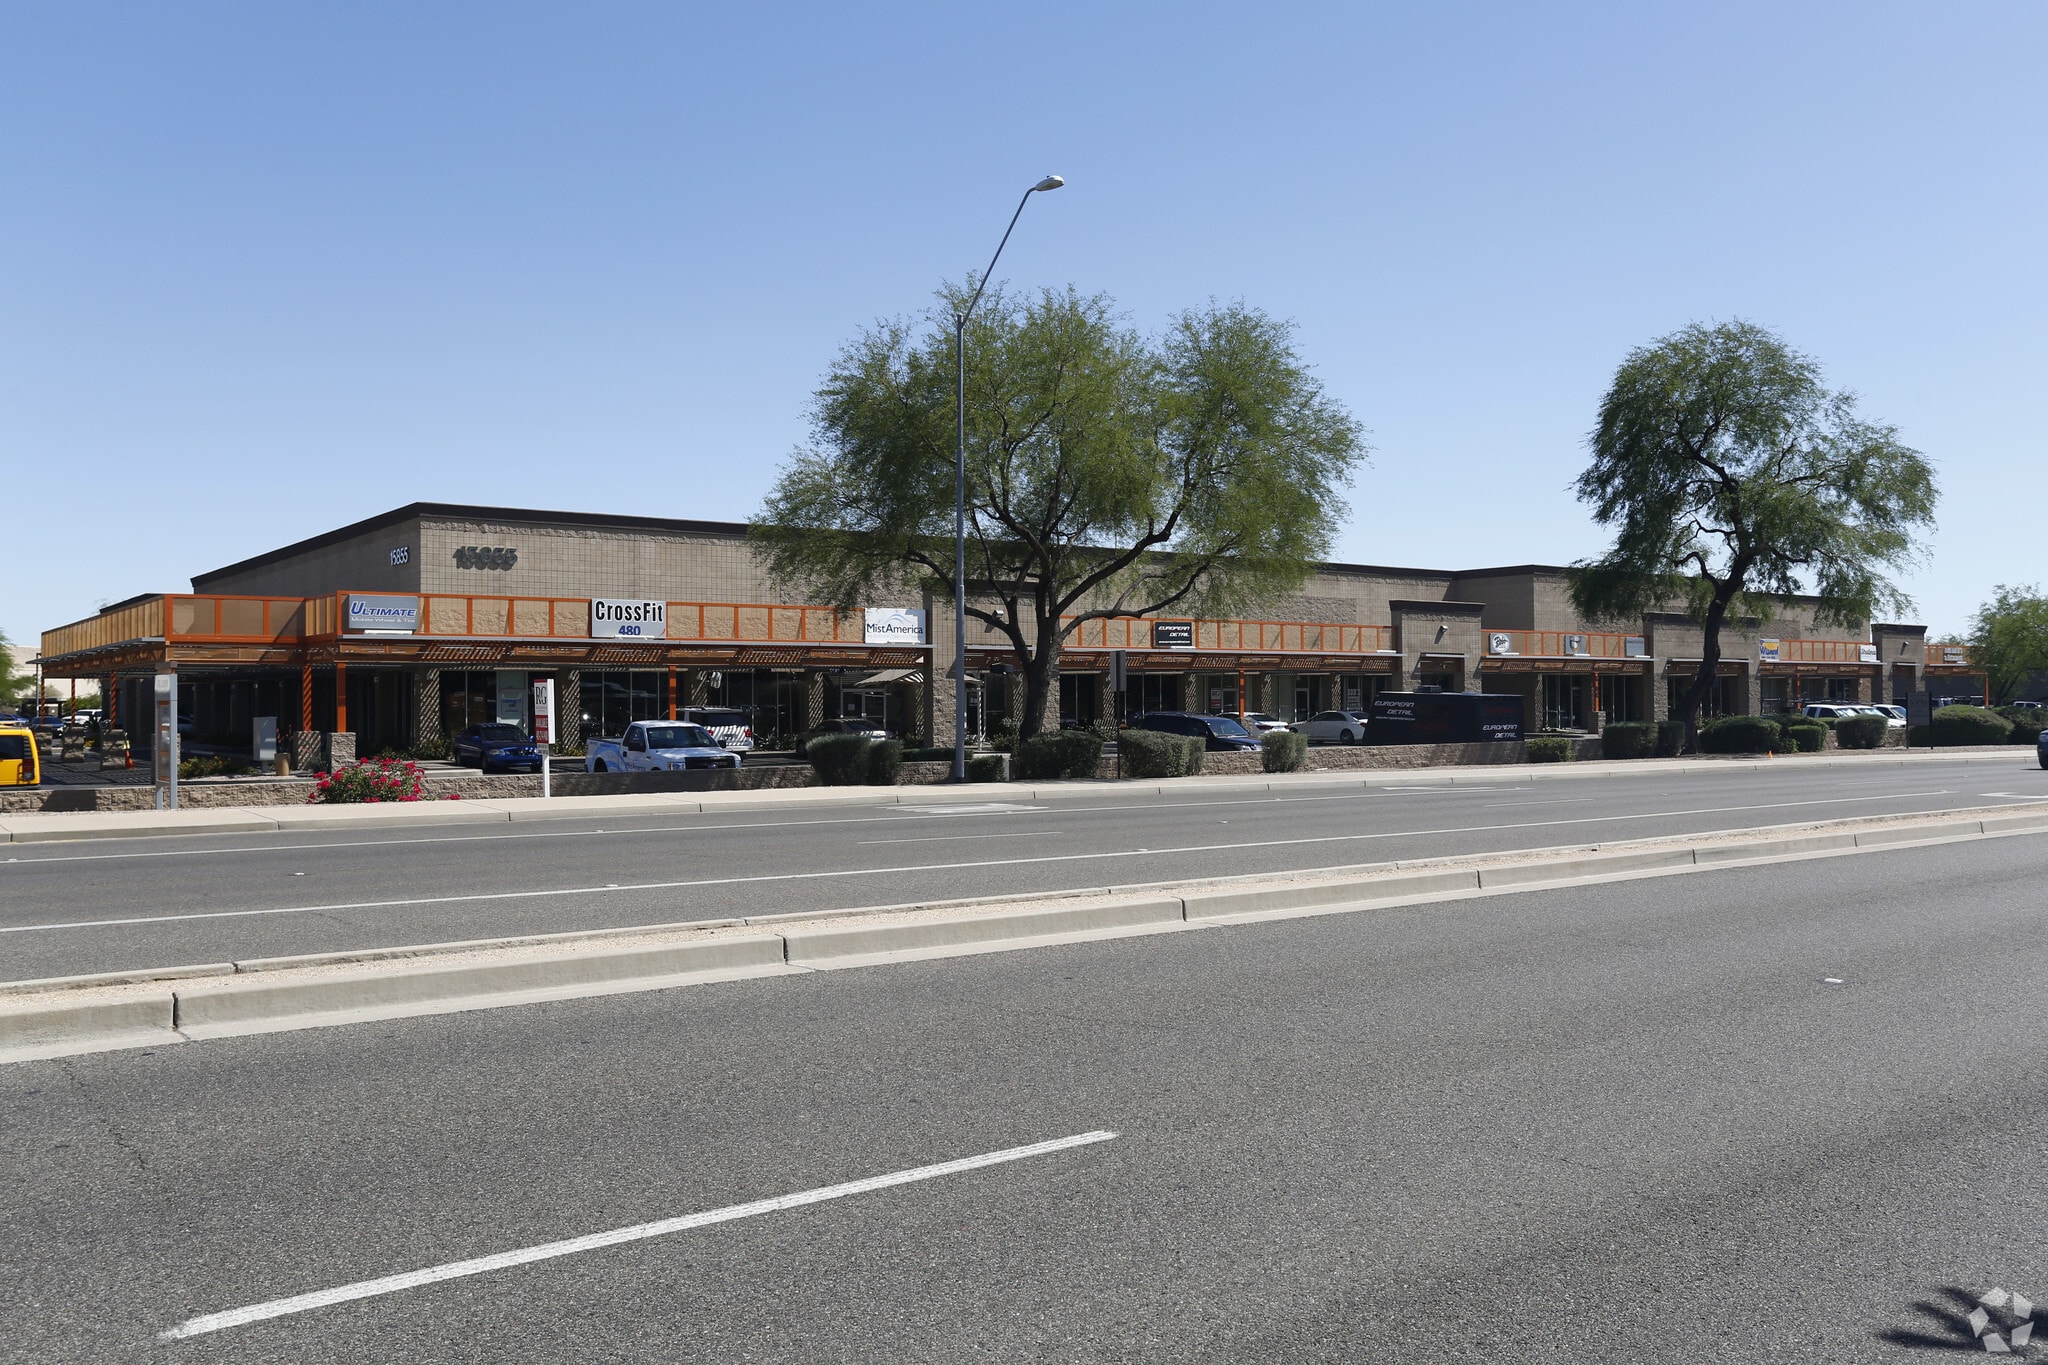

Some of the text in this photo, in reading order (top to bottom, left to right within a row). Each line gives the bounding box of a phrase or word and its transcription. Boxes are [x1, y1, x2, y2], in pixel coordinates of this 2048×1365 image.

[390, 546, 408, 566] 15855
[460, 546, 518, 565] 15855
[595, 600, 663, 622] CrossFit
[618, 625, 641, 636] 480
[866, 623, 924, 634] MistAmerica
[1374, 700, 1415, 708] EUROPEAN
[1387, 708, 1413, 716] DETAIL
